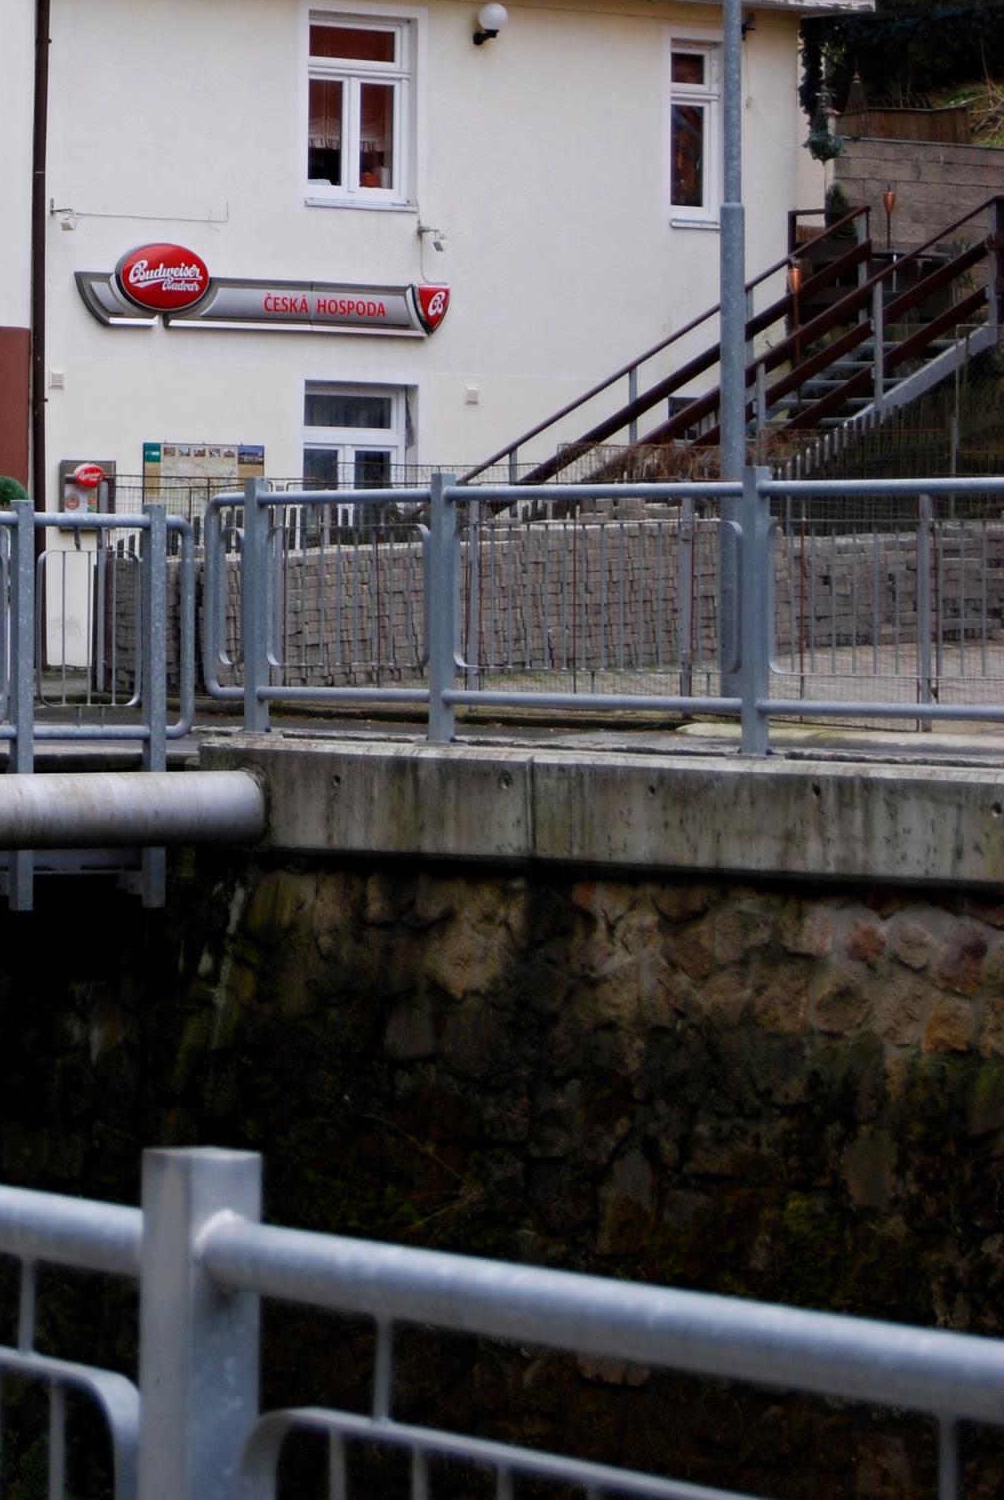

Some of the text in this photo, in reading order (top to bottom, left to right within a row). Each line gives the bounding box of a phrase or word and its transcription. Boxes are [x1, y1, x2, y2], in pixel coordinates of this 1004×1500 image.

[129, 259, 203, 287] Budweiser
[161, 277, 201, 291] Budvar
[263, 293, 387, 318] ČESKÁ HOSPODA
